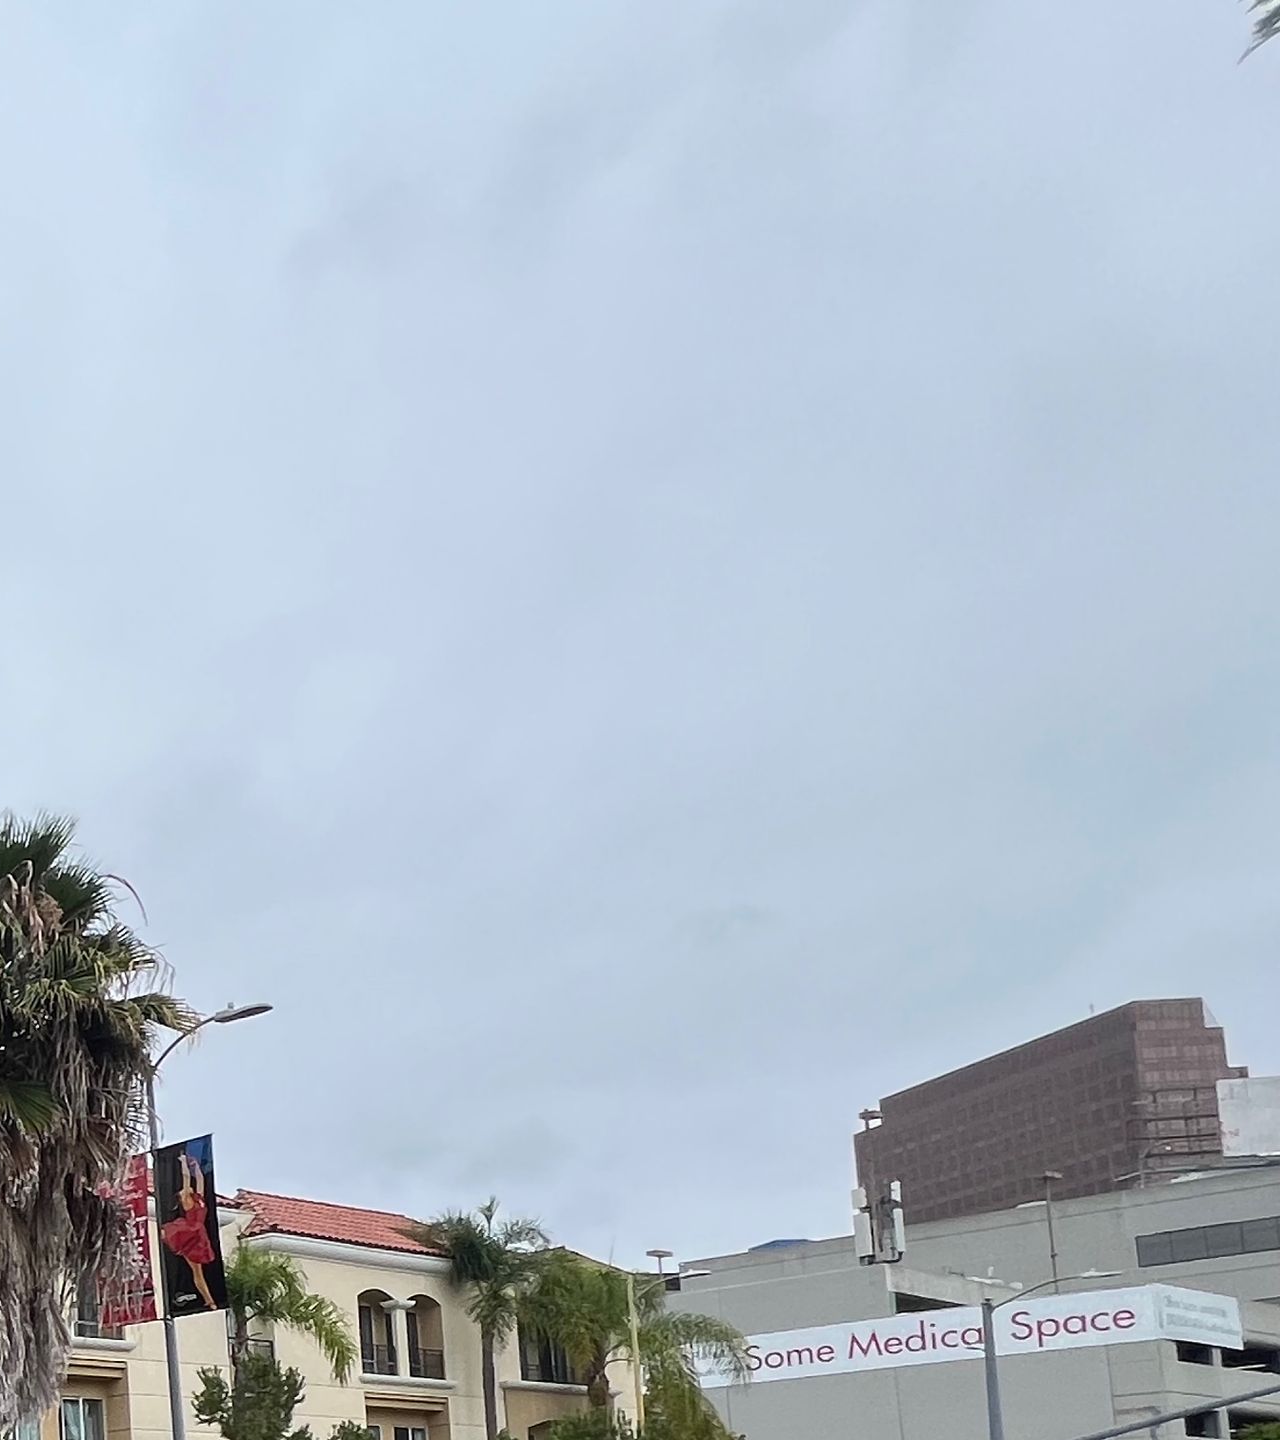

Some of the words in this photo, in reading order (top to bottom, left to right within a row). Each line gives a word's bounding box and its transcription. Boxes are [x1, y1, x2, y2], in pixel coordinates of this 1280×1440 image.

[744, 1344, 835, 1372] Some
[848, 1319, 985, 1360] Medica
[1010, 1308, 1138, 1348] Space
